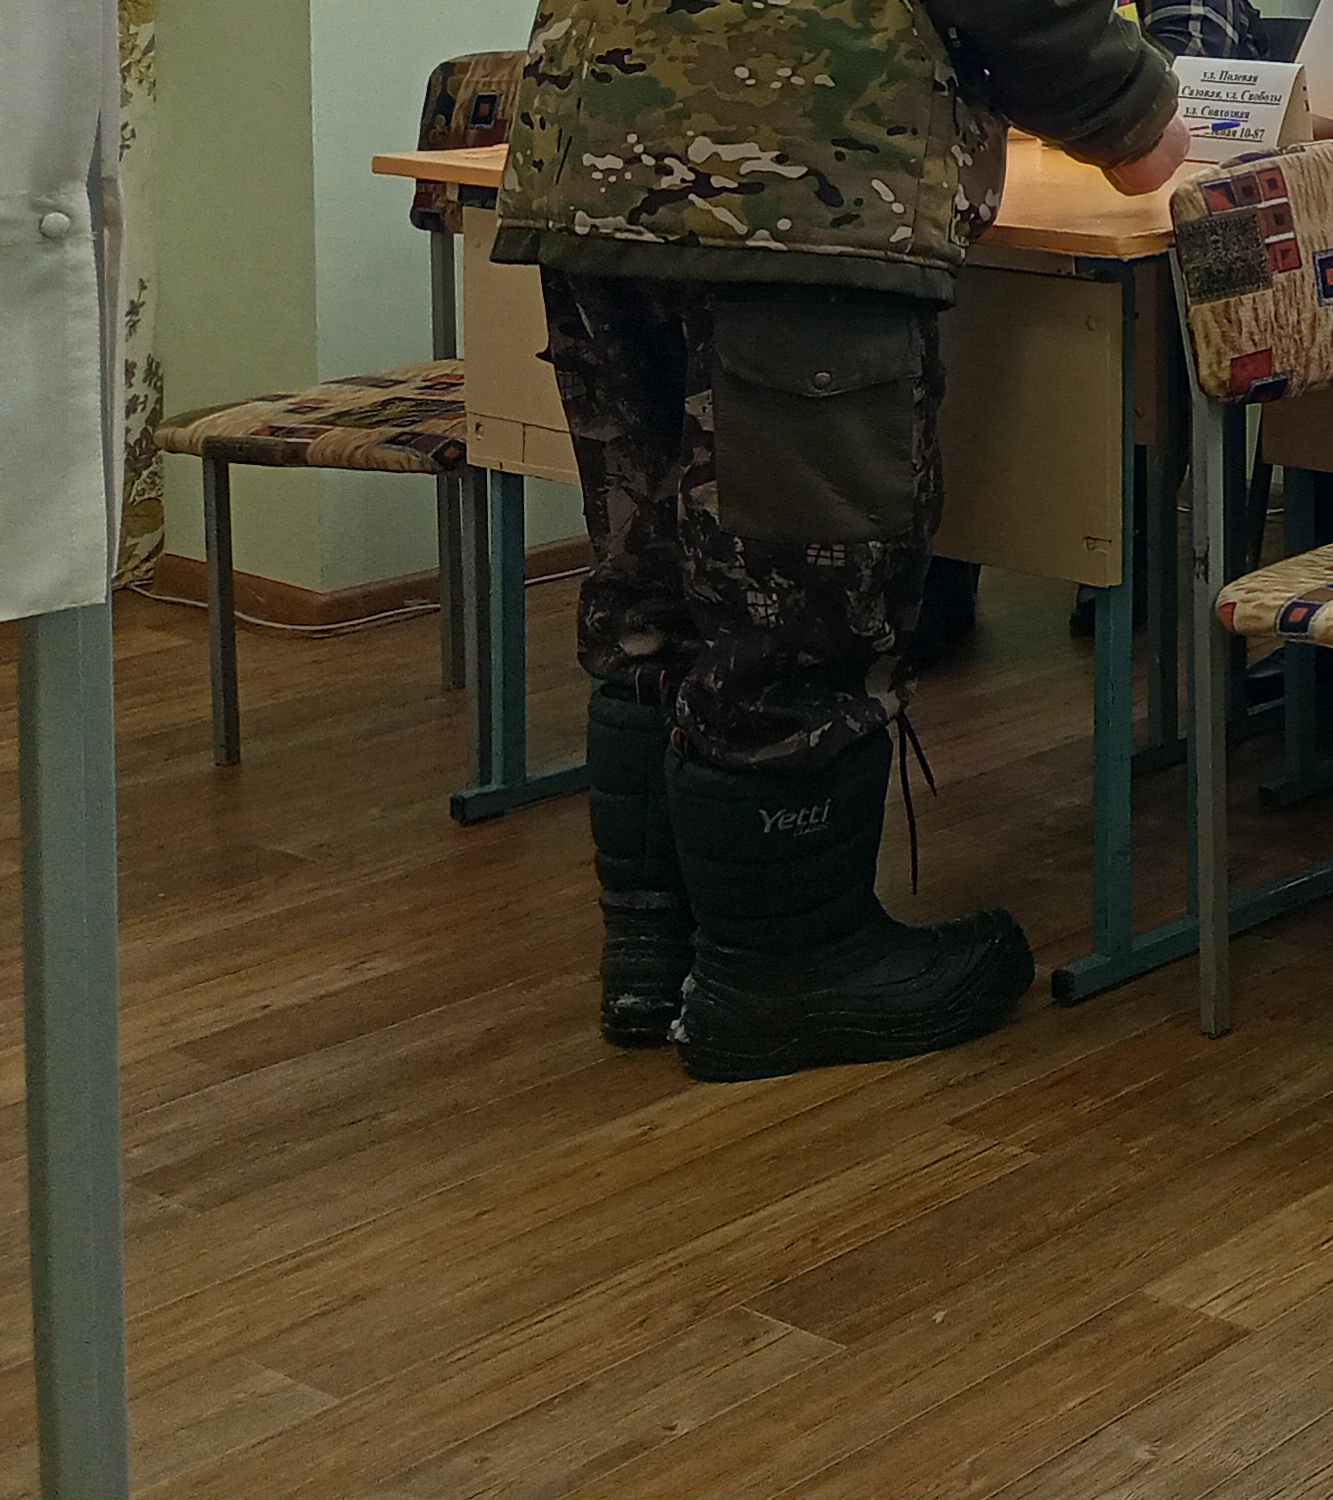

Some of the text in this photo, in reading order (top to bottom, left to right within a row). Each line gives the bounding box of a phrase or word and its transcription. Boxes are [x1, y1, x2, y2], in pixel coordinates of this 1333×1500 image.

[1219, 69, 1259, 84] Полевая
[1239, 127, 1266, 140] 10-87
[758, 798, 832, 833] Yetti
